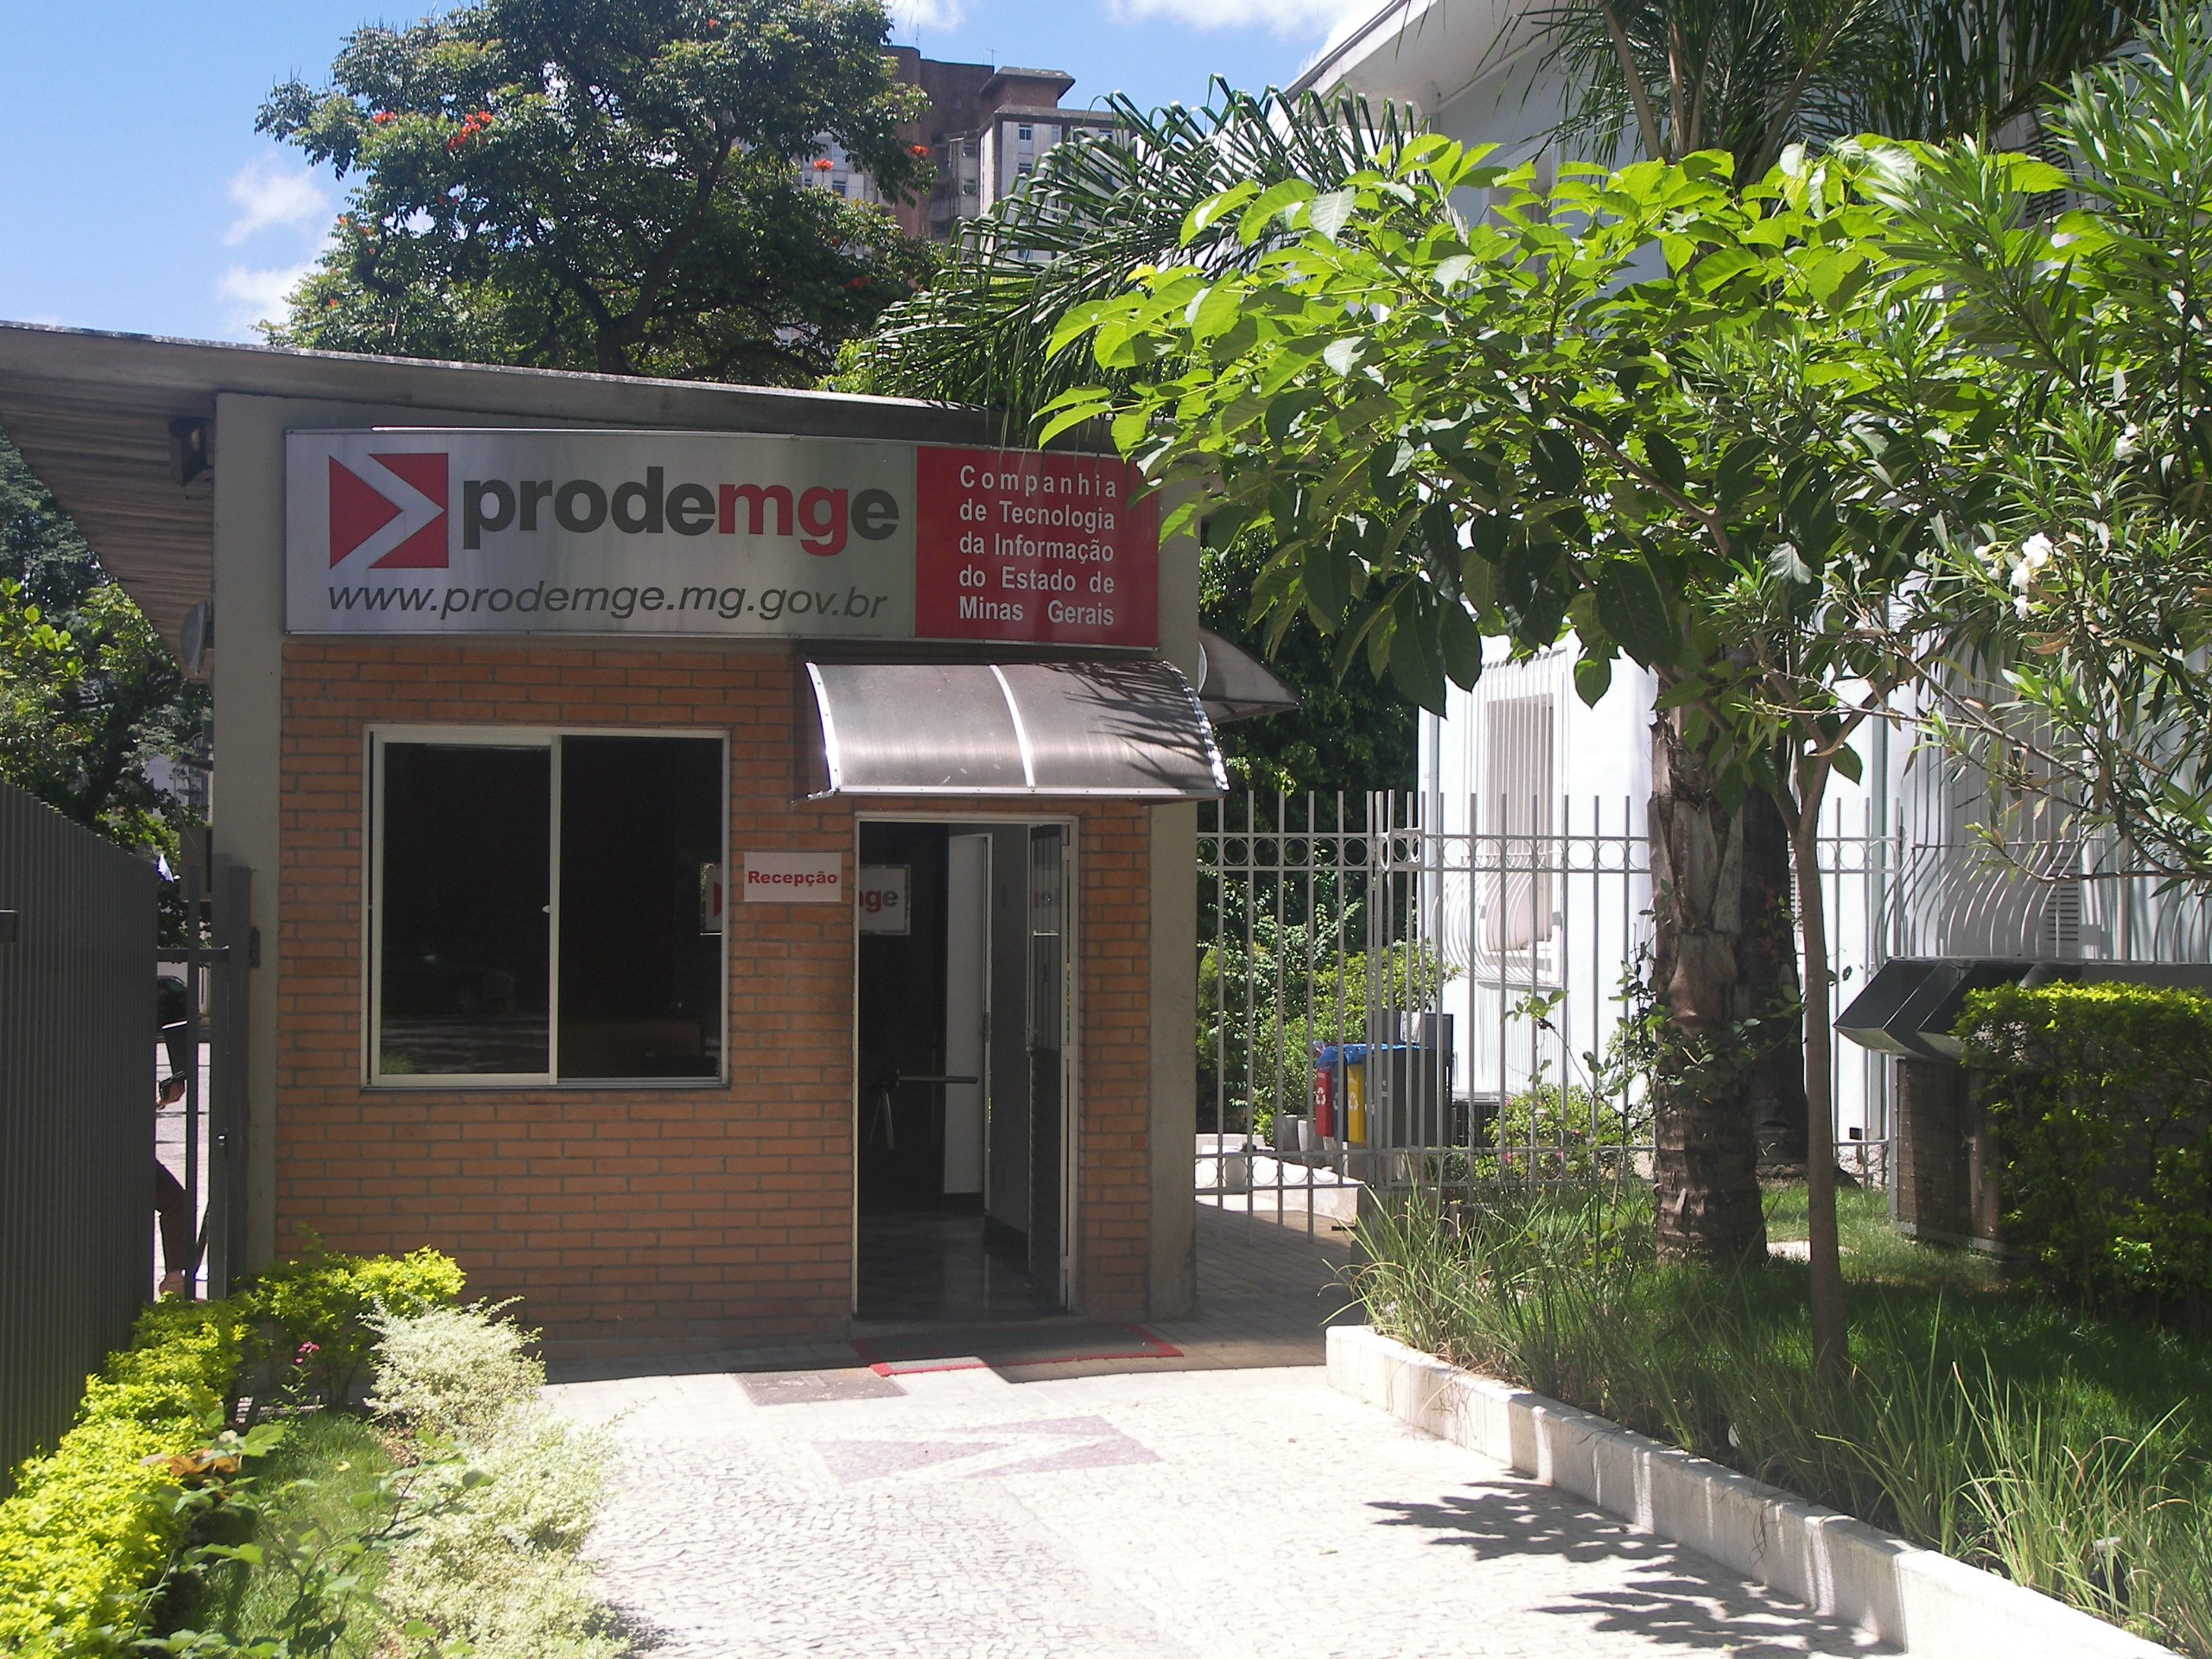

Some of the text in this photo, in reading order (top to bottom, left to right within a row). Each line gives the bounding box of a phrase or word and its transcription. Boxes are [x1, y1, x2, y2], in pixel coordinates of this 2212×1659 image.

[959, 464, 1116, 498] Companhia
[463, 467, 899, 556] prodemge
[959, 499, 1115, 534] de Tecnologia
[959, 531, 1114, 564] da Informação
[959, 564, 1115, 594] do Estado de
[328, 581, 888, 621] www.prodemge.mg.gov.br
[959, 595, 1115, 626] Minas Gerais
[747, 870, 837, 887] Recepção
[859, 890, 899, 913] ge
